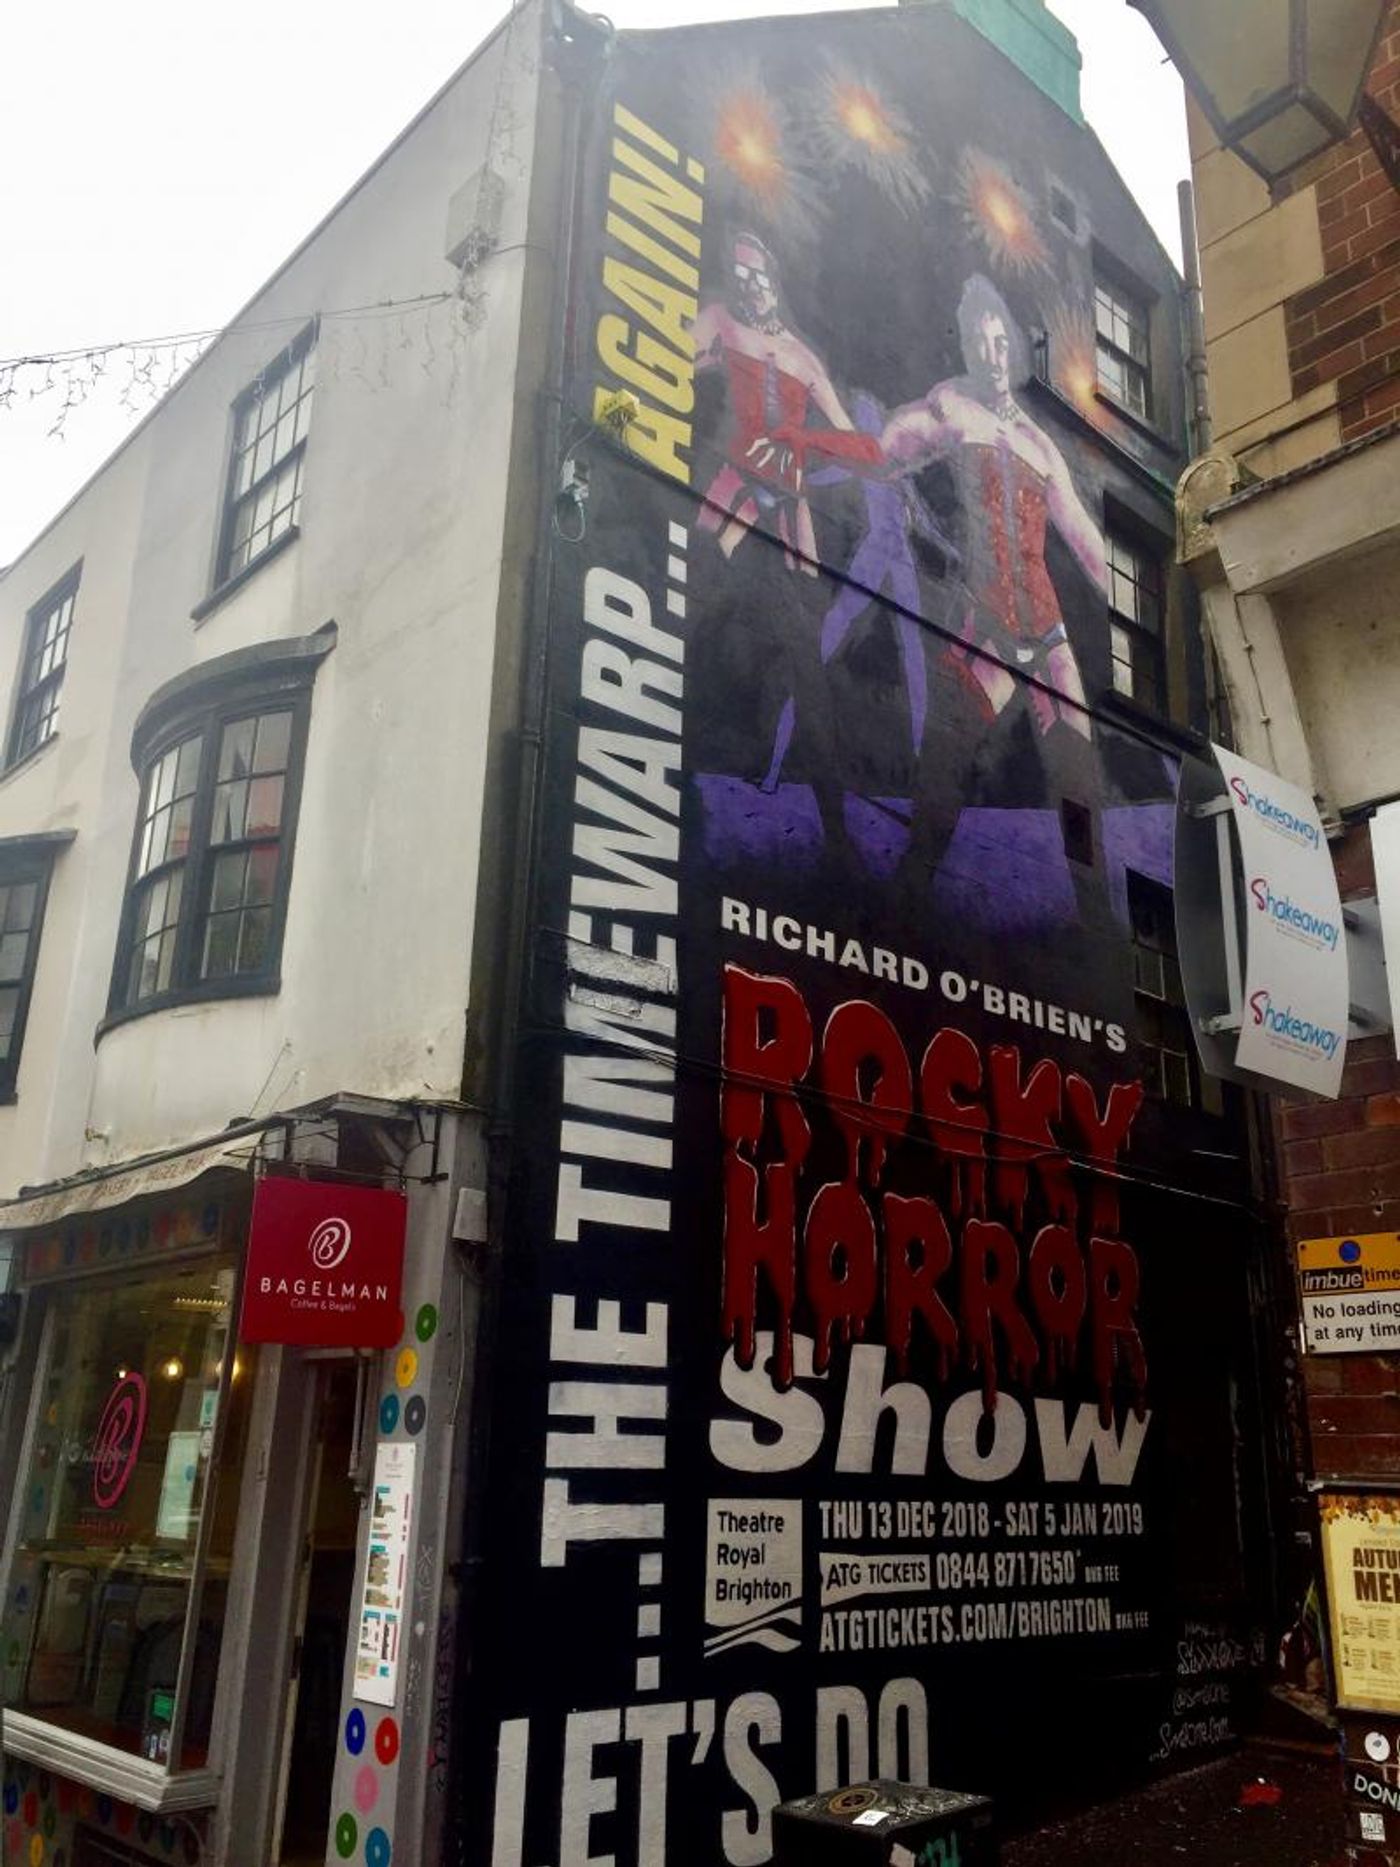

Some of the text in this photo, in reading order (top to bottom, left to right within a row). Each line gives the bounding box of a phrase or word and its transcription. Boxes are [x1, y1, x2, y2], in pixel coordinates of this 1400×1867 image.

[594, 103, 705, 485] AGAIN!
[1231, 777, 1319, 850] Shakeaway
[1251, 878, 1339, 952] Shakeaway
[721, 896, 1127, 1053] RICHARD O'BRIEN'S
[1250, 990, 1341, 1060] Shakeaway
[720, 961, 1143, 1205] ROCKY
[720, 1140, 1149, 1390] HORROR
[1305, 1271, 1362, 1289] imbue
[260, 1276, 387, 1301] BAGELMAN
[320, 1300, 327, 1310] &
[1313, 1304, 1335, 1319] No
[1314, 1326, 1329, 1340] at
[1336, 1326, 1363, 1341] any
[709, 1331, 1153, 1485] Show
[717, 1511, 785, 1533] Theatre
[818, 1501, 862, 1539] THU
[868, 1501, 892, 1539] 13
[897, 1500, 935, 1538] DEC
[942, 1501, 990, 1537] 2018
[1005, 1501, 1039, 1536] SAT
[1044, 1502, 1057, 1536] 5
[1060, 1502, 1098, 1536] JAN
[1102, 1502, 1143, 1535] 2019
[716, 1544, 765, 1569] Royal
[826, 1560, 926, 1591] ATG TICKETS
[935, 1552, 990, 1590] 0844
[1353, 1547, 1400, 1569] AUTU
[715, 1578, 792, 1605] Brighton
[819, 1597, 1111, 1653] ATGTICKETS.COM/BRIGHTON
[491, 1691, 782, 1867] LET'S
[1354, 1773, 1400, 1812] DON
